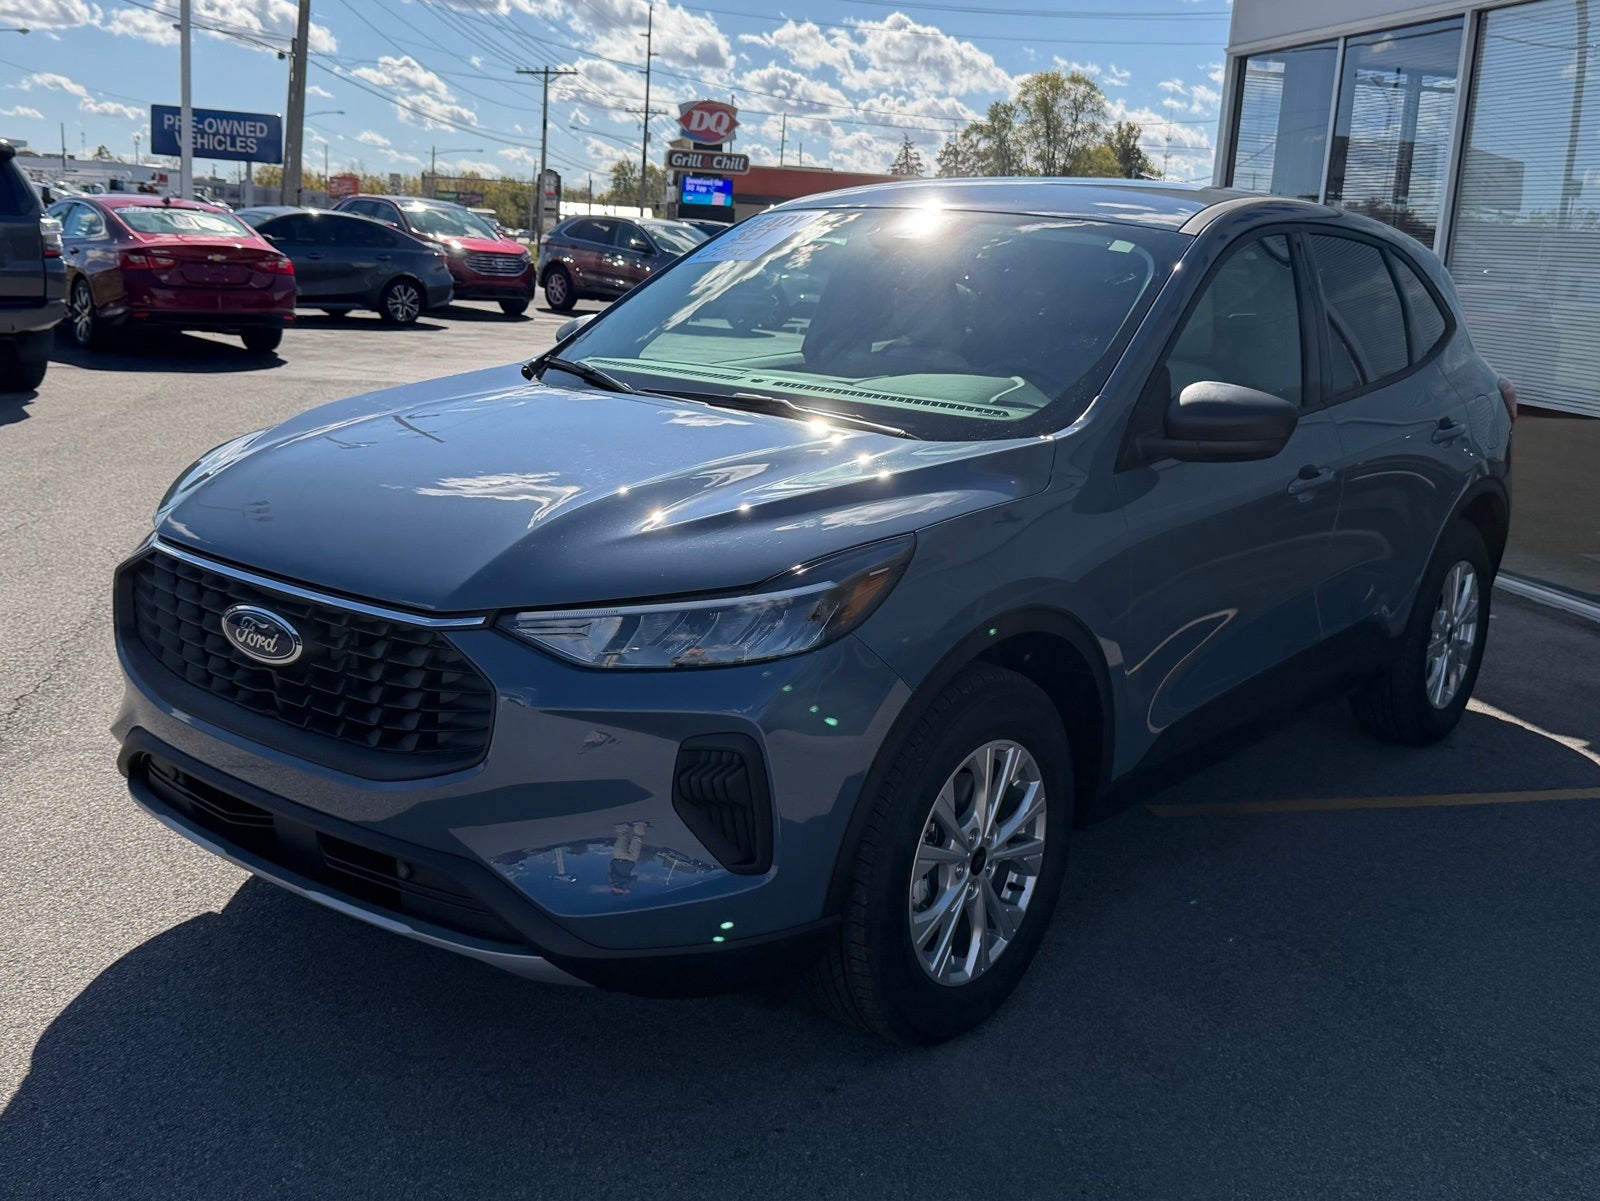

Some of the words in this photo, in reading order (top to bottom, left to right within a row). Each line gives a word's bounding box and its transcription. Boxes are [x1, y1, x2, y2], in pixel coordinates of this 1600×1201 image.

[689, 110, 730, 136] DQ
[671, 153, 702, 168] Grill
[712, 156, 745, 171] Chill
[235, 616, 280, 653] Ford
